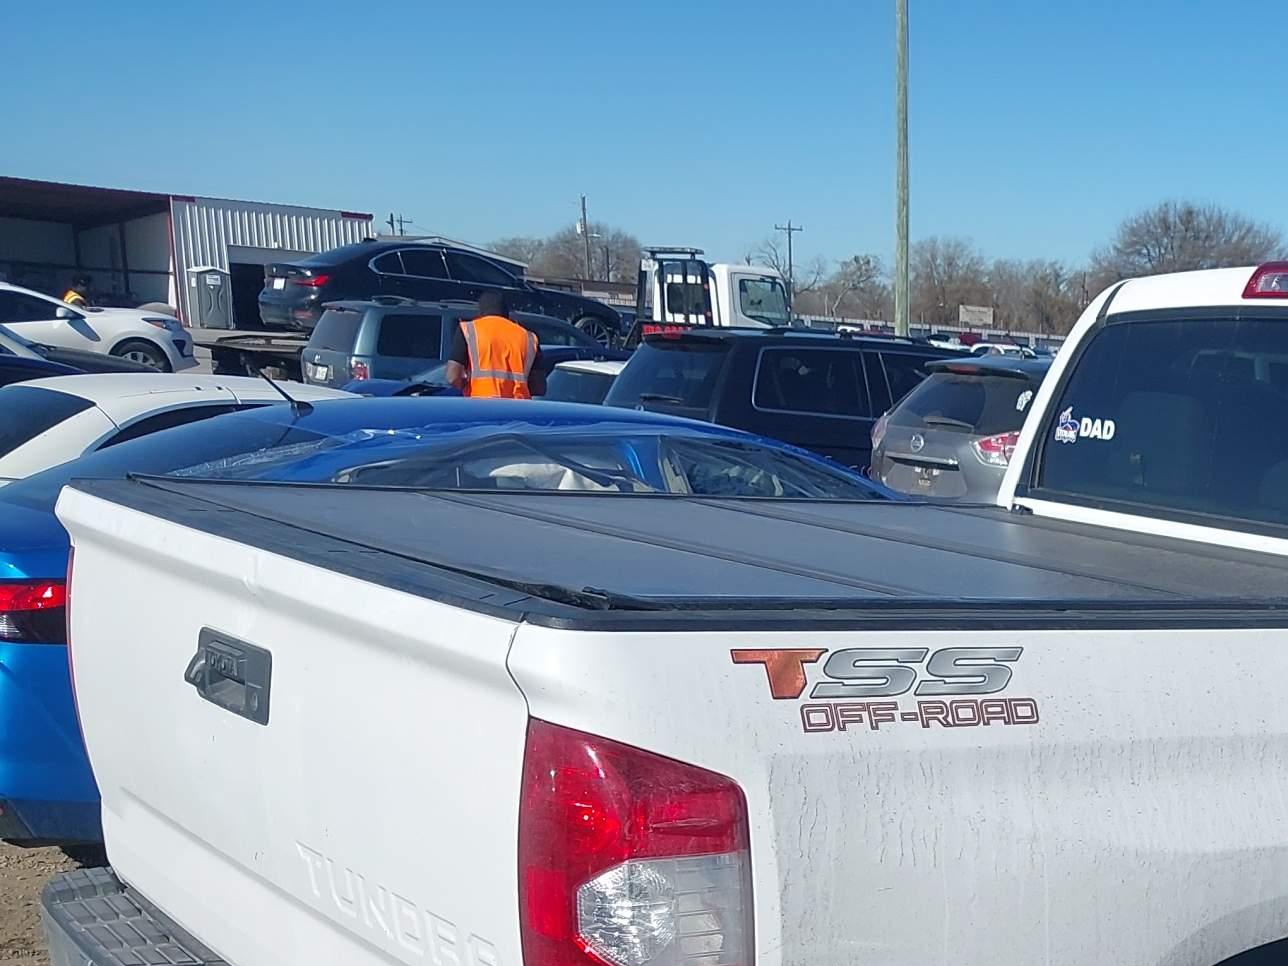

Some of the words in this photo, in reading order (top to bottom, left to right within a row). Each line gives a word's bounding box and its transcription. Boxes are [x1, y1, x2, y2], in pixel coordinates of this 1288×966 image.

[1079, 417, 1116, 441] DAD
[730, 647, 1024, 700] TSS
[799, 697, 1039, 734] OFF-ROAD
